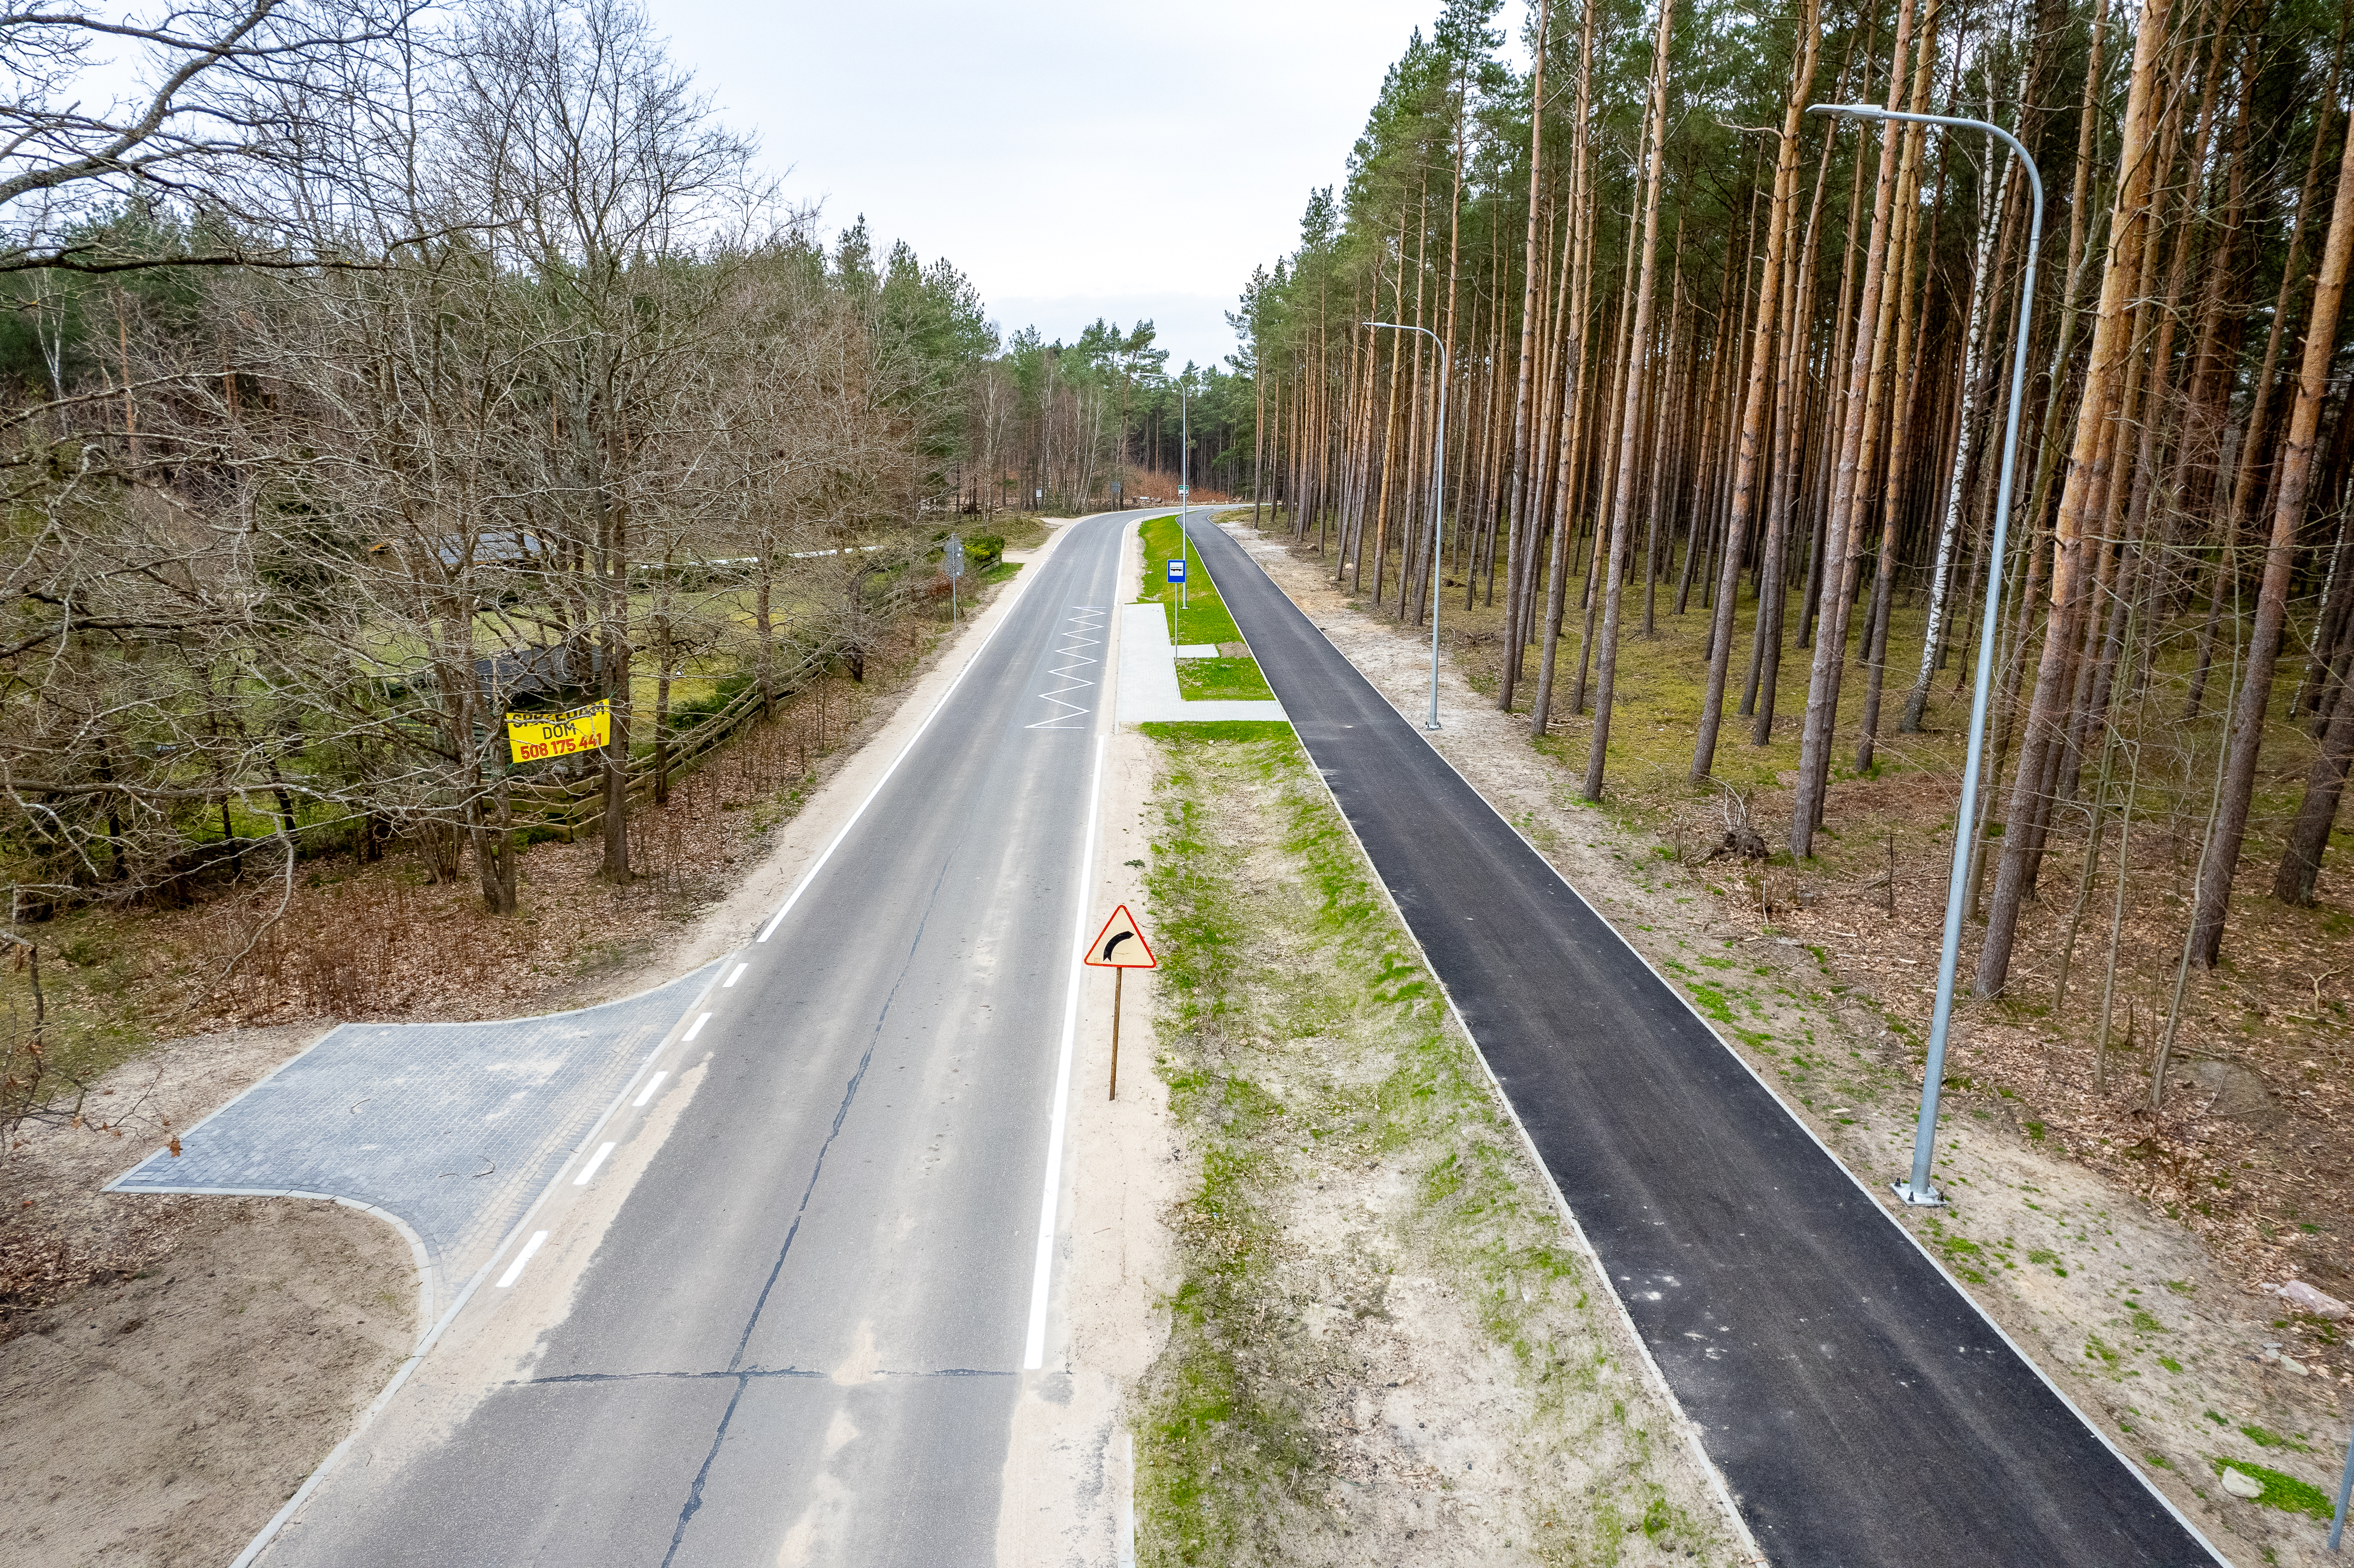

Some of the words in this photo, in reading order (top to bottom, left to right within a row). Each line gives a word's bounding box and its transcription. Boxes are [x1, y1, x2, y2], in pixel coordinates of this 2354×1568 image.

[543, 723, 576, 740] DOM
[520, 743, 548, 760] 508
[551, 738, 576, 754] 175
[579, 733, 601, 749] 441
